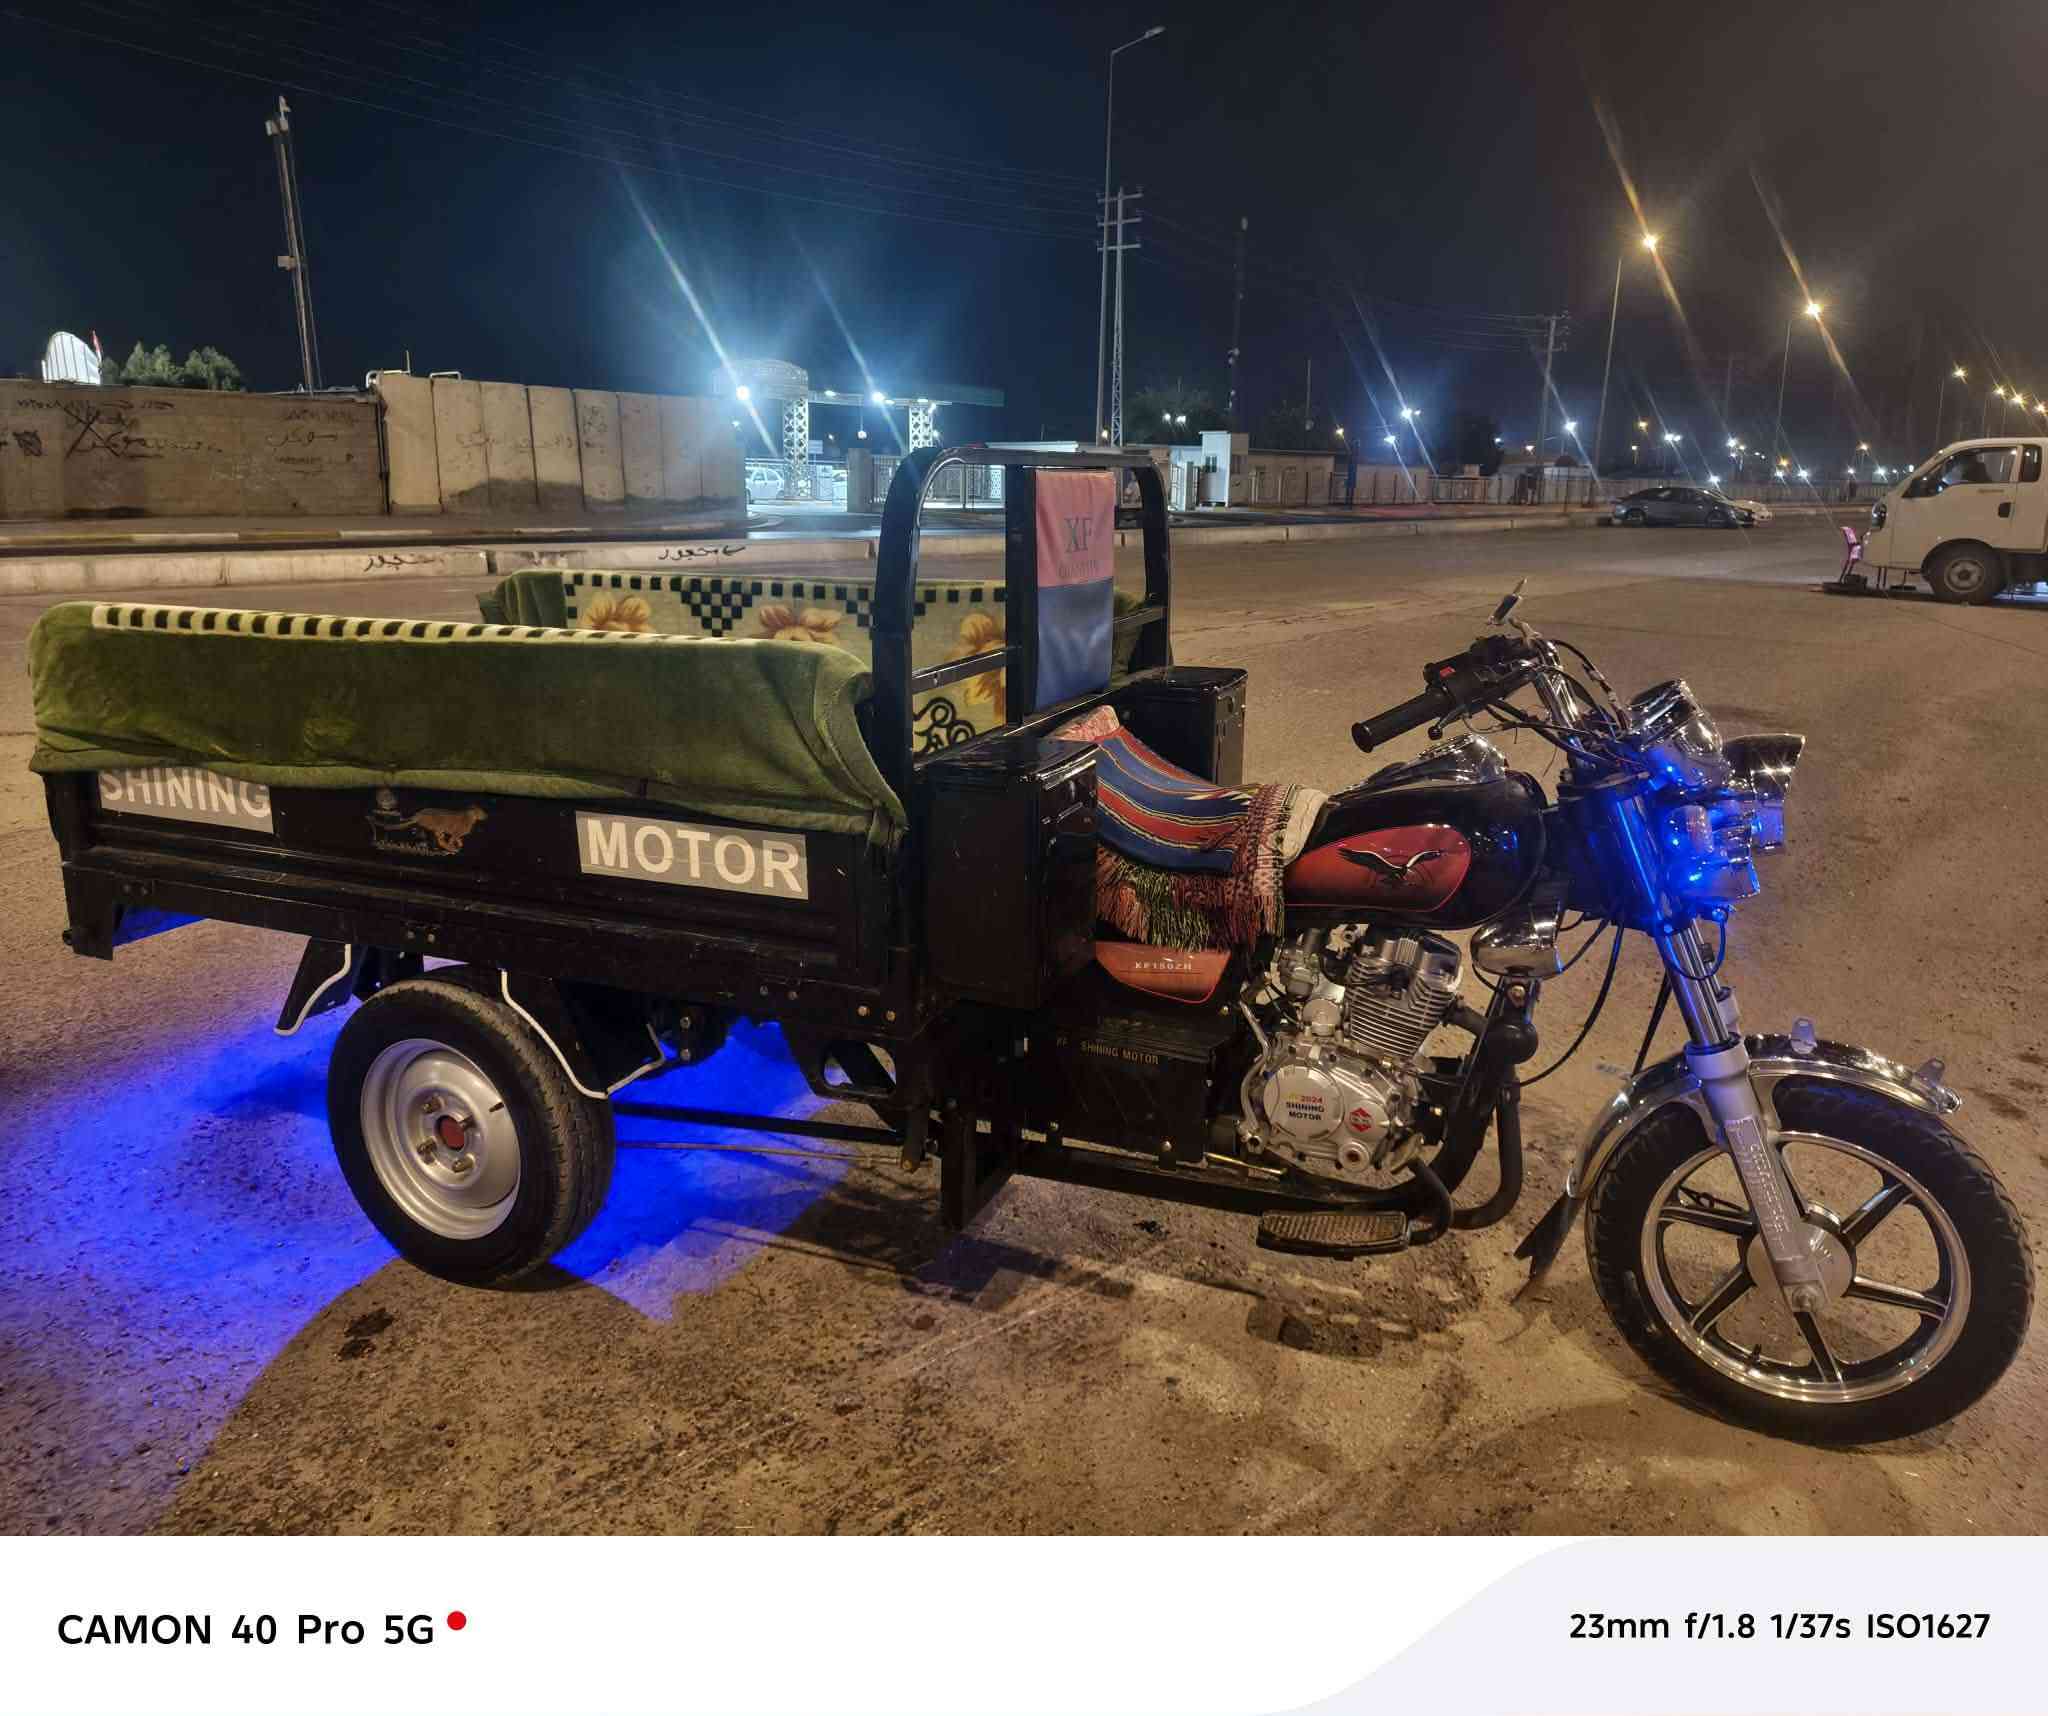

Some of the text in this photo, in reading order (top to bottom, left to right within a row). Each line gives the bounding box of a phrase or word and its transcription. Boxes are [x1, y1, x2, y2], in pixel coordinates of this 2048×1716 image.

[1063, 516, 1093, 552] XF
[587, 818, 802, 892] MOTOR
[1080, 1040, 1119, 1057] SHINING
[1121, 1047, 1159, 1065] MOTOR
[1286, 1101, 1325, 1113] SHINING
[1289, 1111, 1322, 1121] MOTOR
